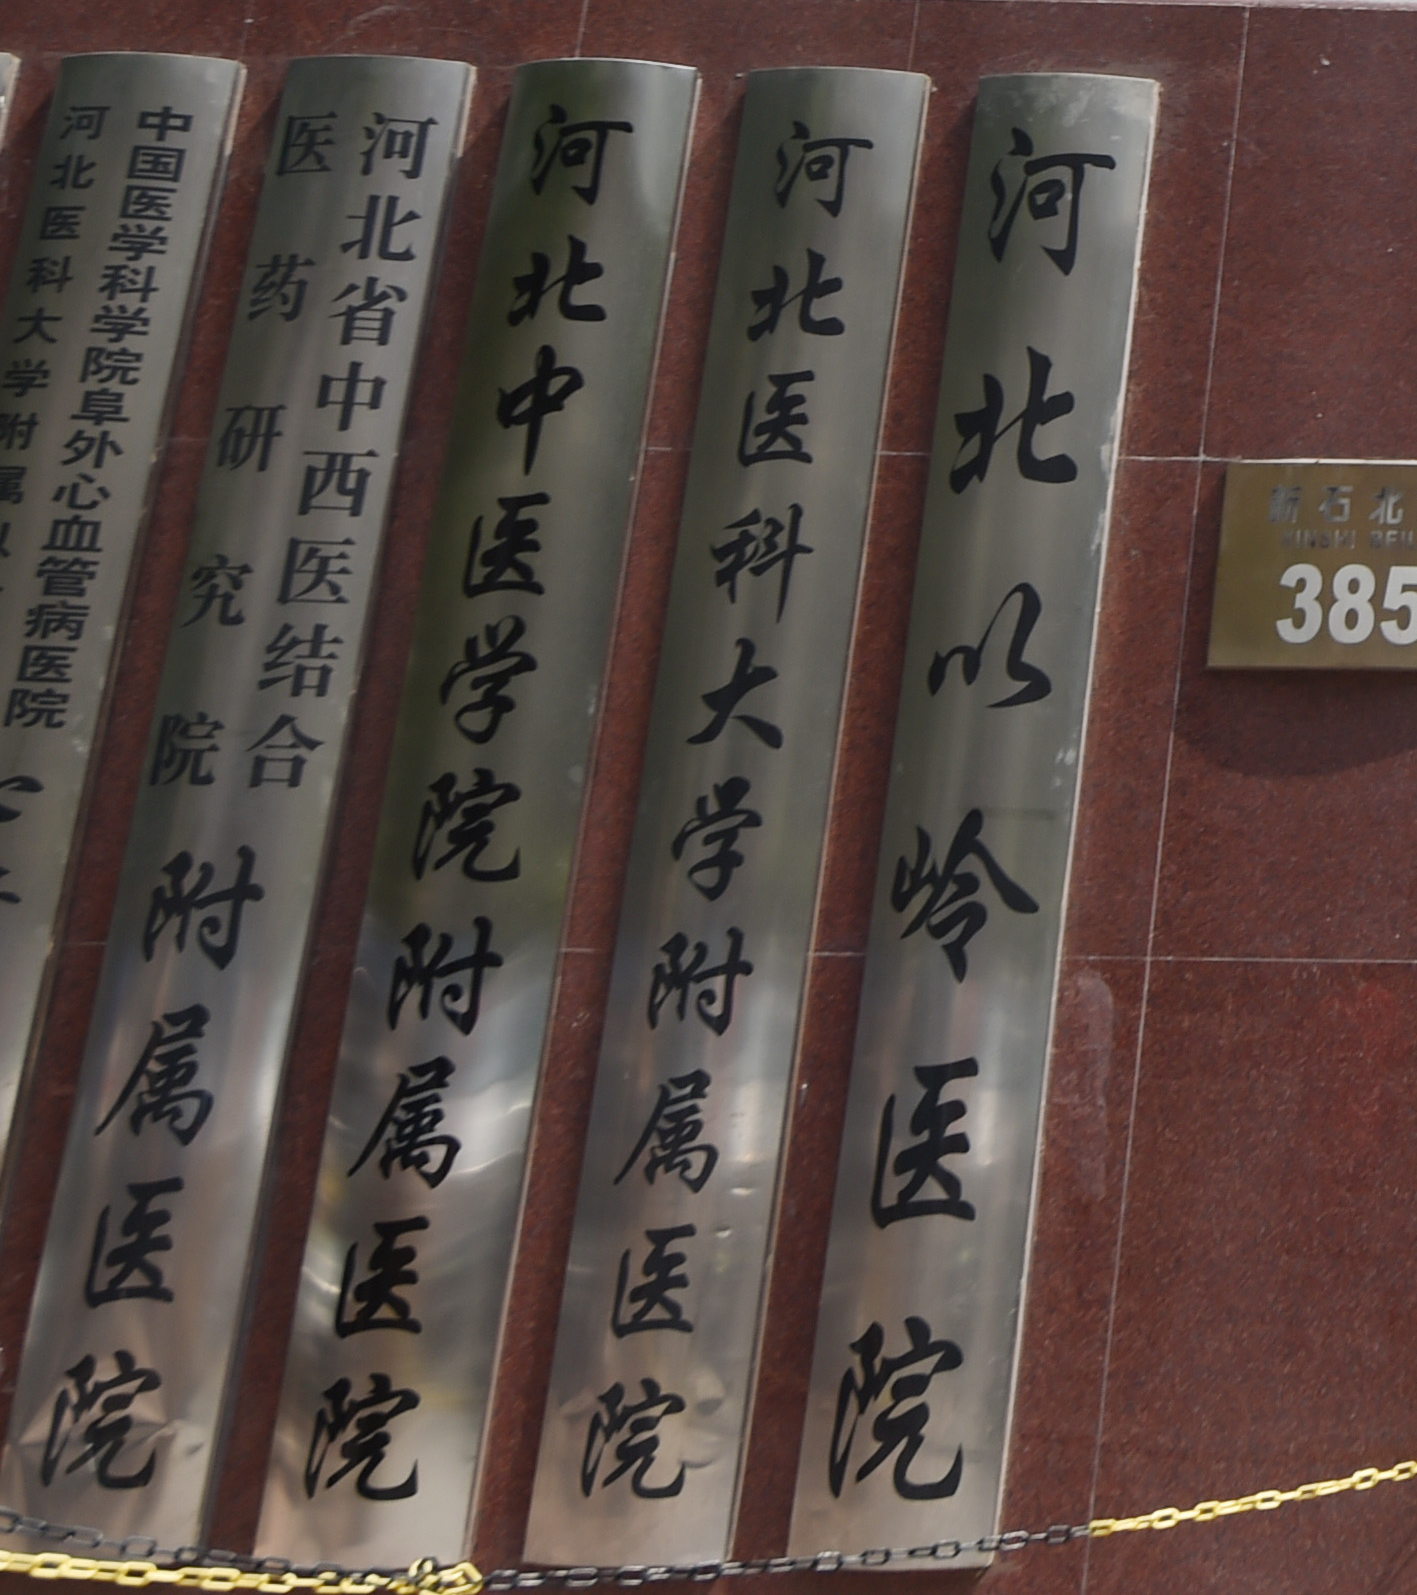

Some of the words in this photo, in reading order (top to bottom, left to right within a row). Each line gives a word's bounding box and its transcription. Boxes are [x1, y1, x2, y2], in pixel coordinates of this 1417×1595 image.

[4, 106, 194, 729] 中国医学科学院阜外心血管病医院
[304, 103, 634, 1501] 河北中医学院附属医院
[580, 120, 874, 1499] 河北医科大学附属医院
